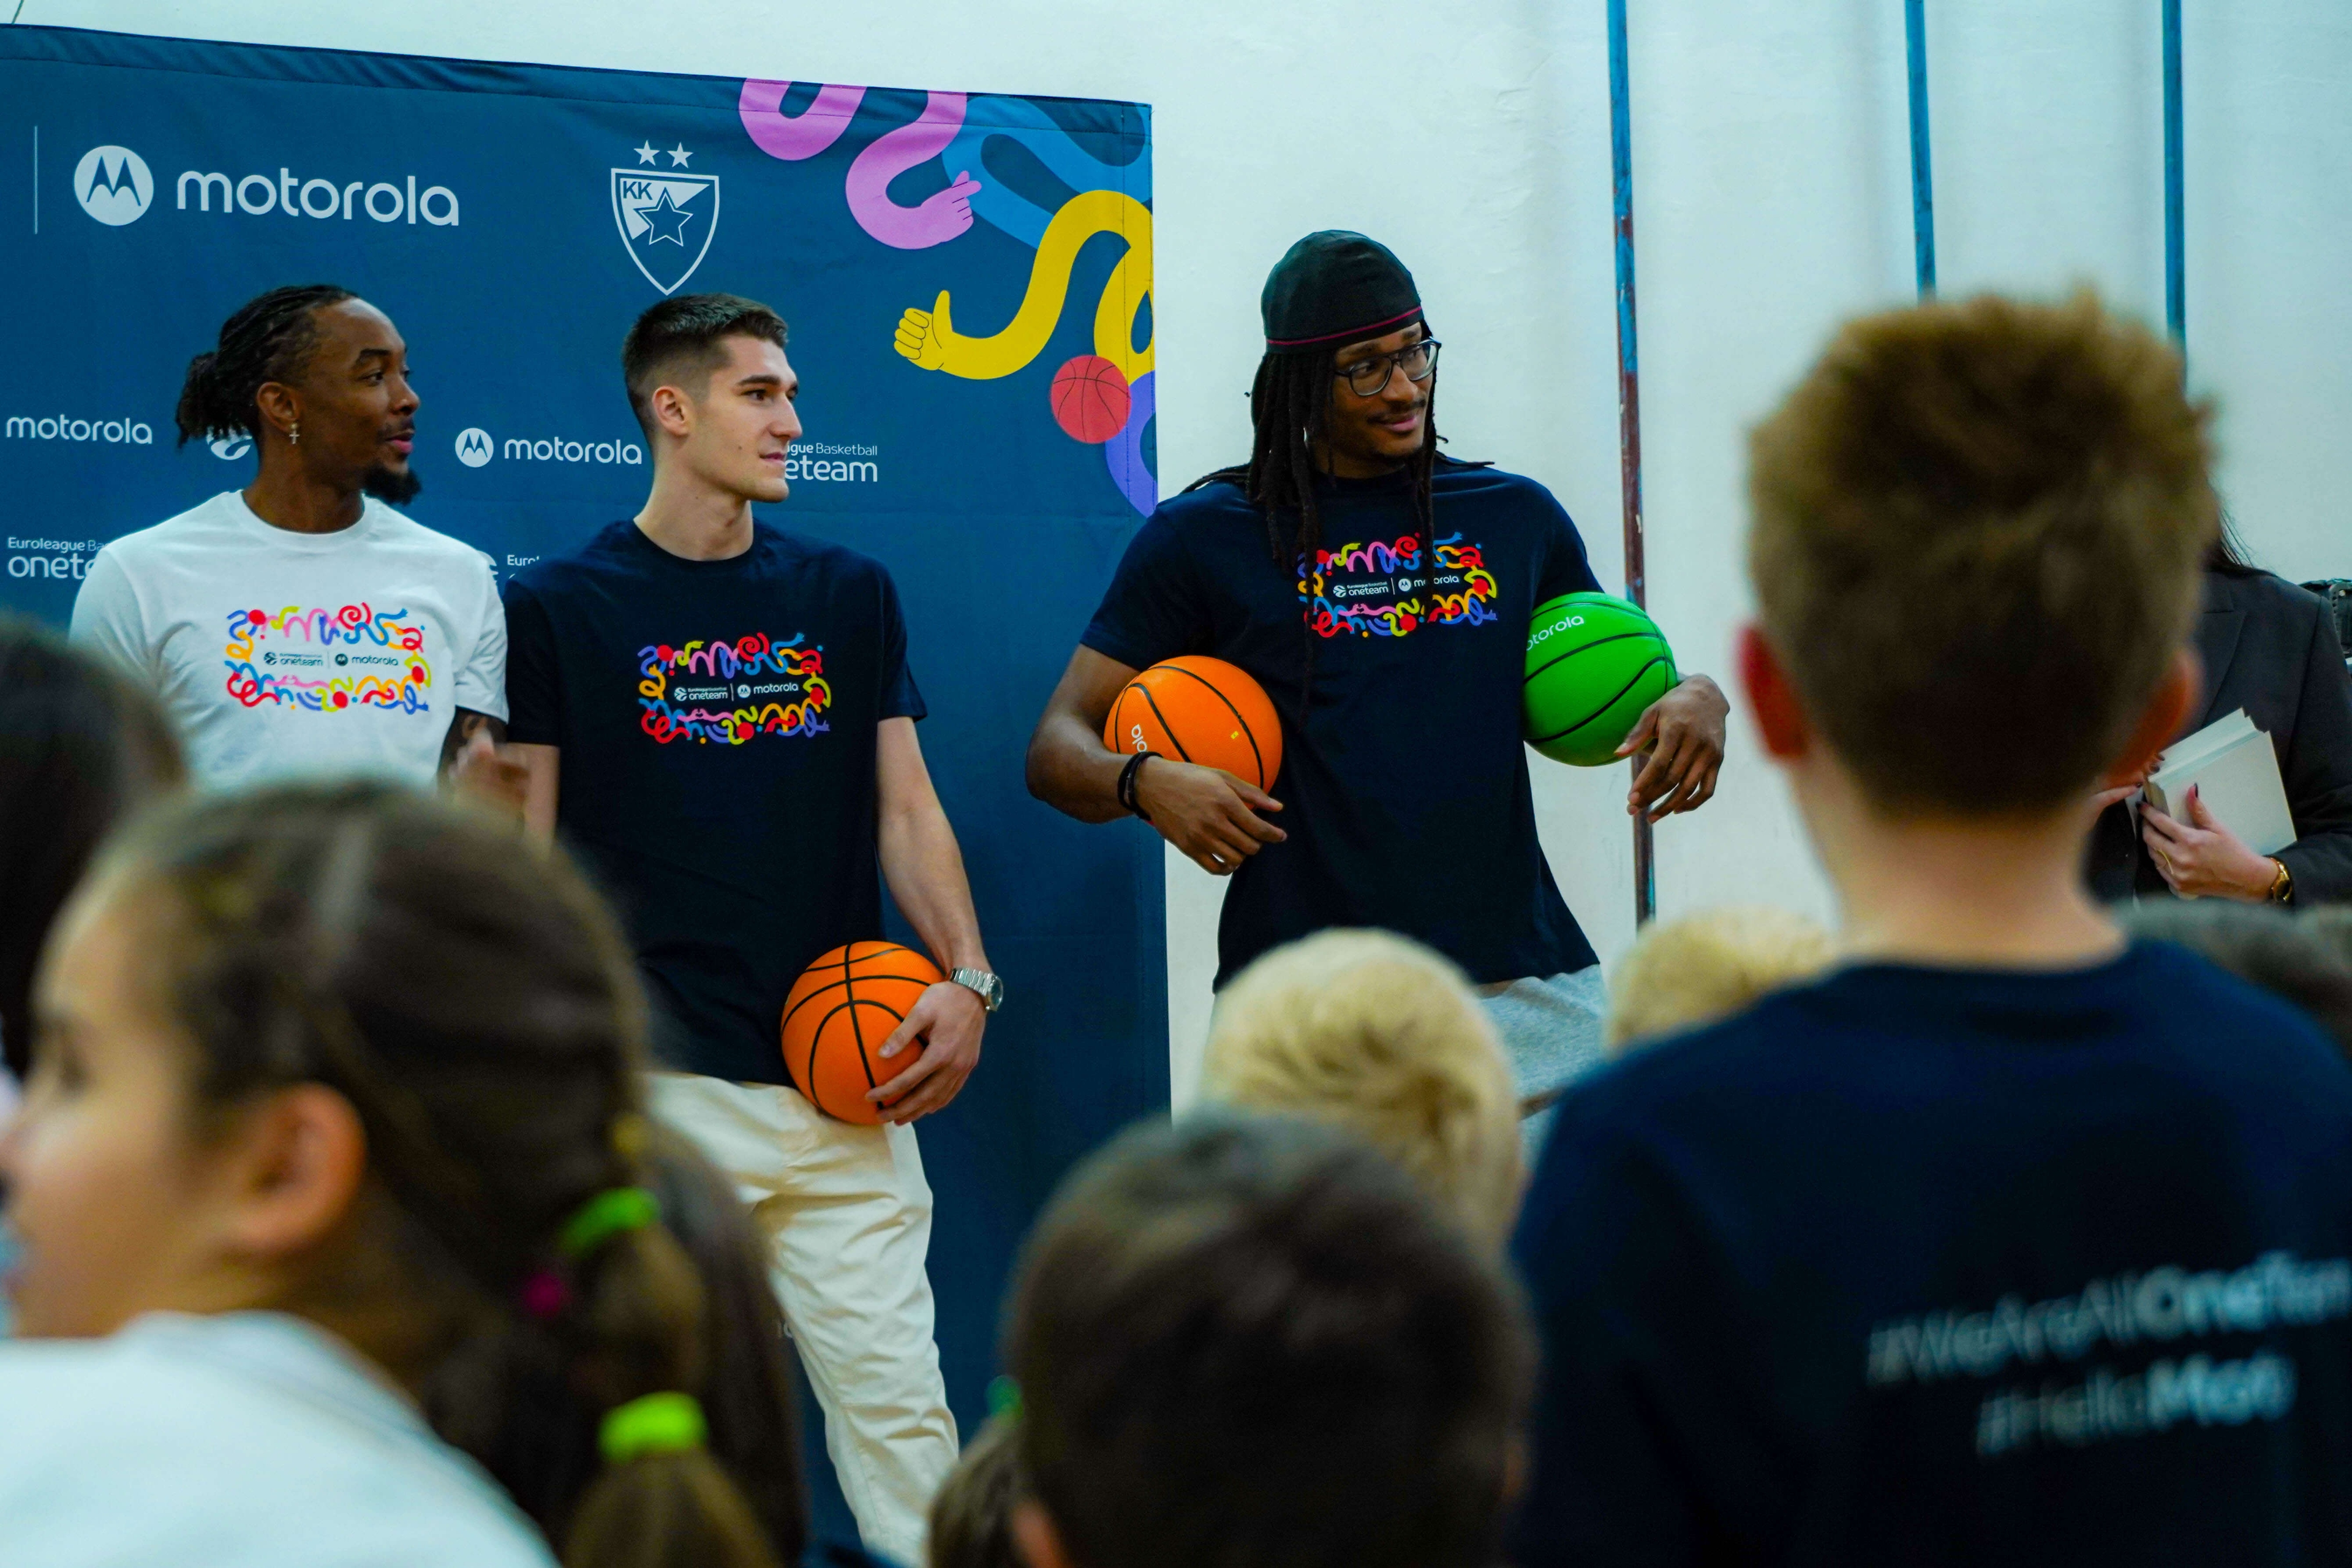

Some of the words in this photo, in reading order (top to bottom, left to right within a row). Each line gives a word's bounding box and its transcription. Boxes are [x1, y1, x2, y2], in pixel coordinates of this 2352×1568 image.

[177, 168, 459, 226] motorola
[622, 181, 652, 200] KK
[6, 414, 153, 444] motorola
[504, 436, 642, 464] motorola
[816, 443, 877, 456] Basketball
[785, 455, 878, 482] eteam
[8, 537, 86, 553] Euroleague
[8, 552, 96, 579] onet
[1414, 575, 1460, 587] morola
[1348, 586, 1389, 596] oneteam
[280, 657, 323, 666] oneteam
[352, 655, 398, 666] motorola
[753, 682, 799, 694] motorola
[688, 691, 728, 701] oneteam
